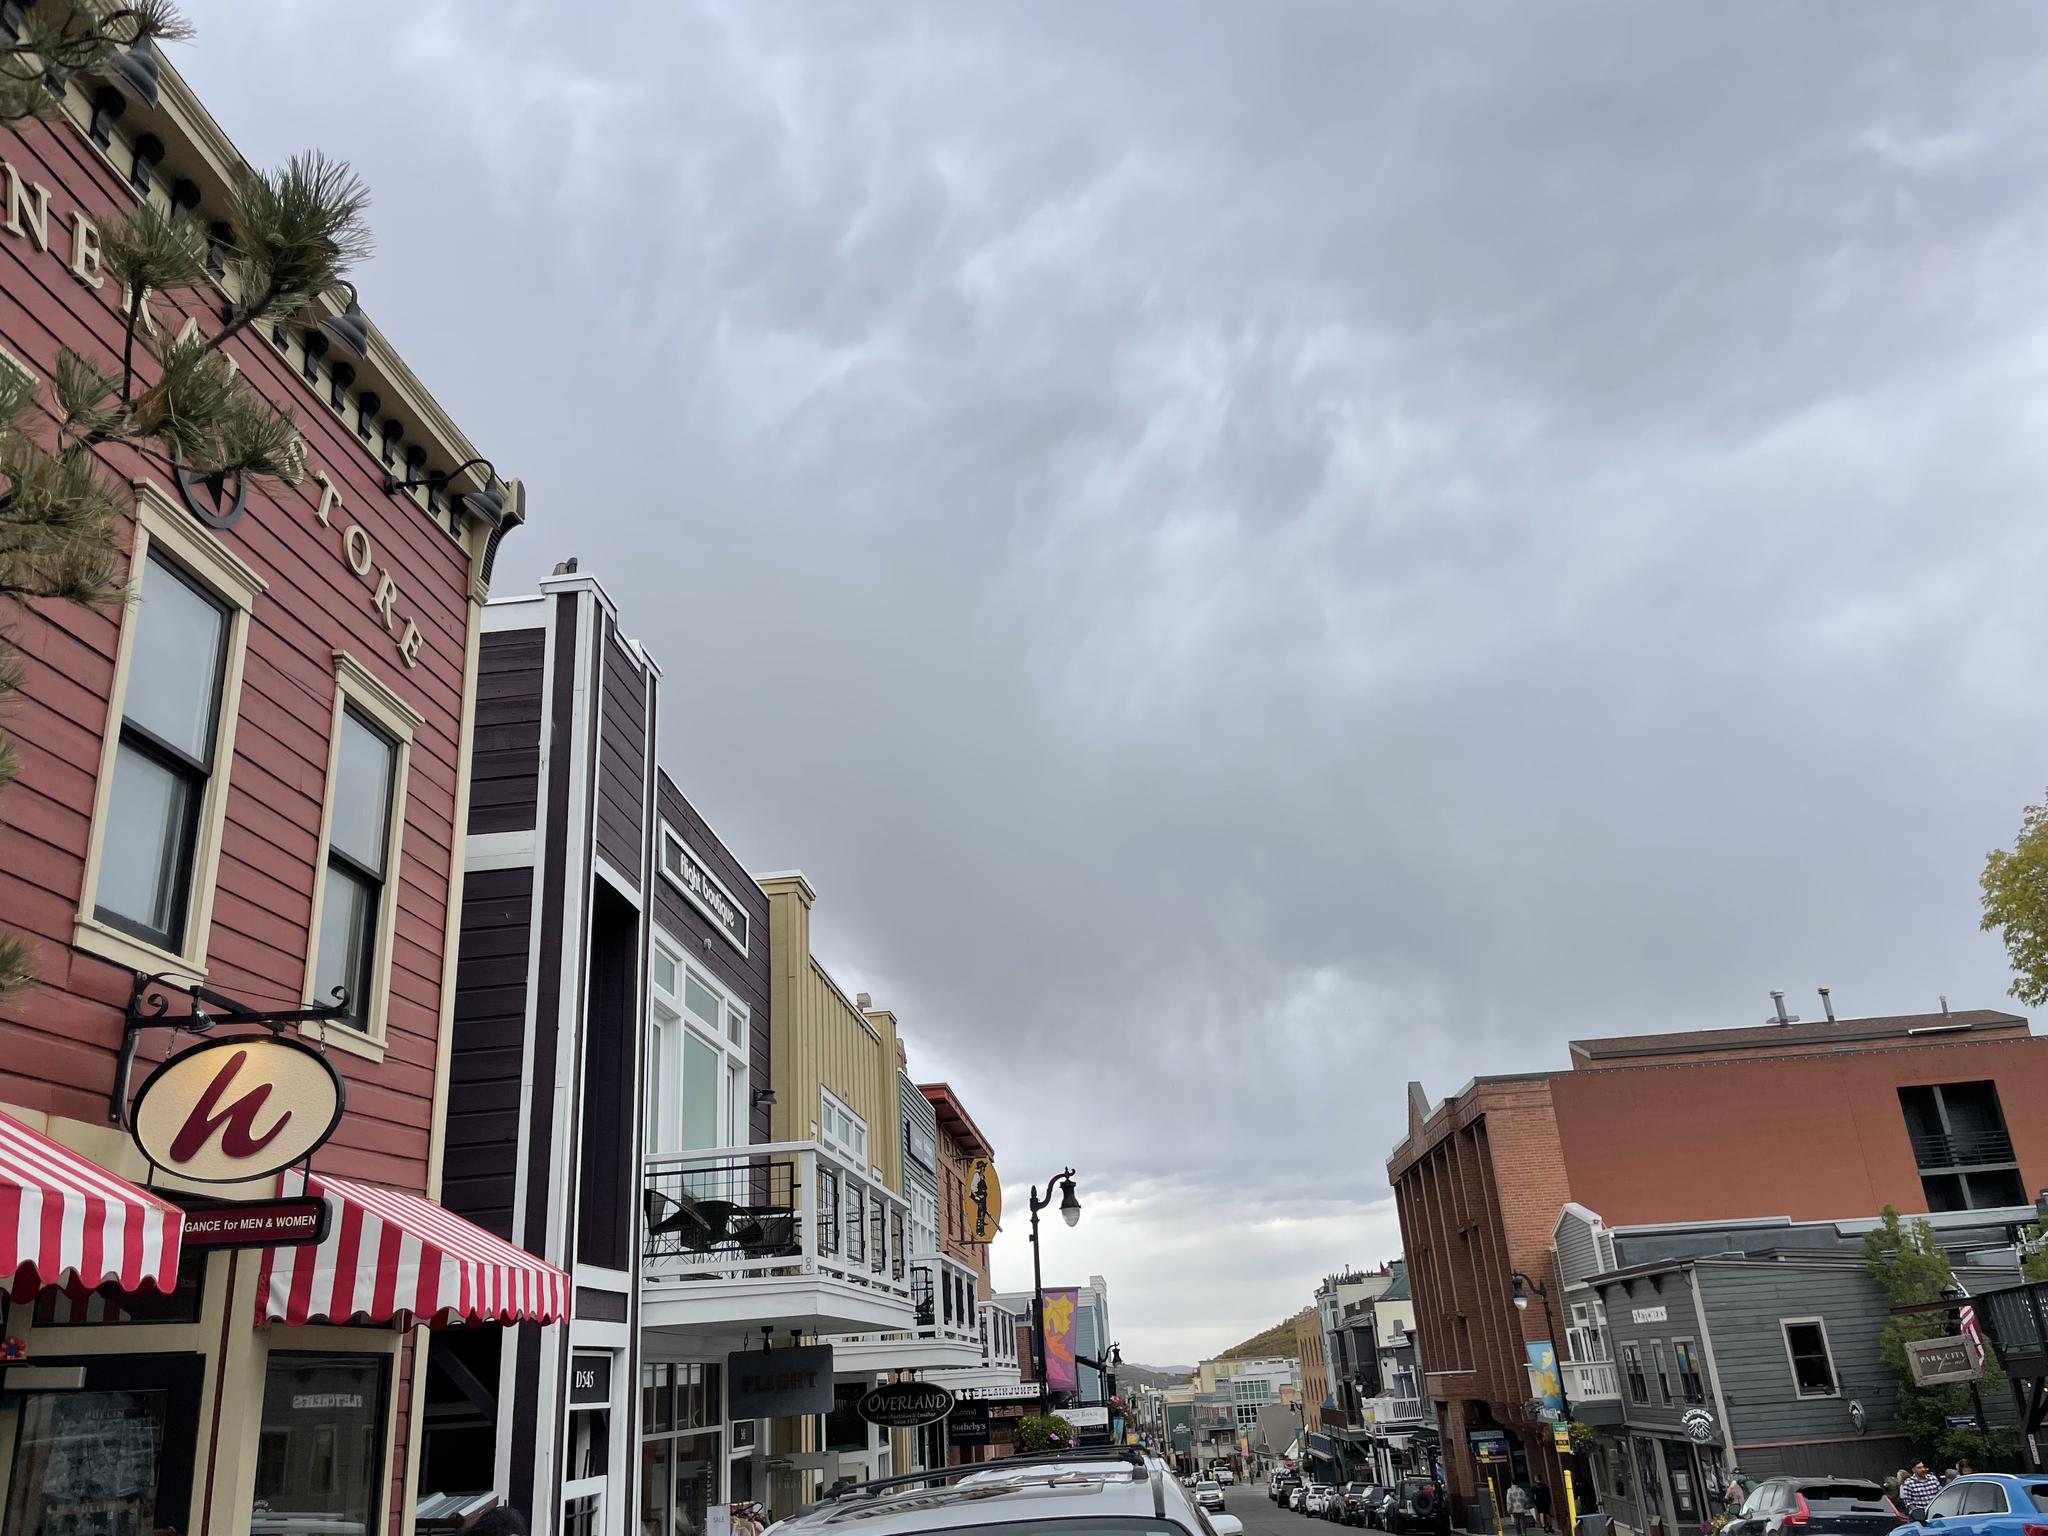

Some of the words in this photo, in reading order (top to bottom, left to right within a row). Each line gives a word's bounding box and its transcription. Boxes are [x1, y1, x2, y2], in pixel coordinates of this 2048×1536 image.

[702, 874, 735, 928] boutique
[223, 1219, 239, 1231] for
[240, 1218, 264, 1230] MEN
[265, 1217, 273, 1228] &
[276, 1215, 317, 1228] WOMEN
[1919, 1354, 1943, 1364] PARK
[1944, 1351, 1965, 1360] CITY
[951, 1422, 987, 1433] Sotheby's
